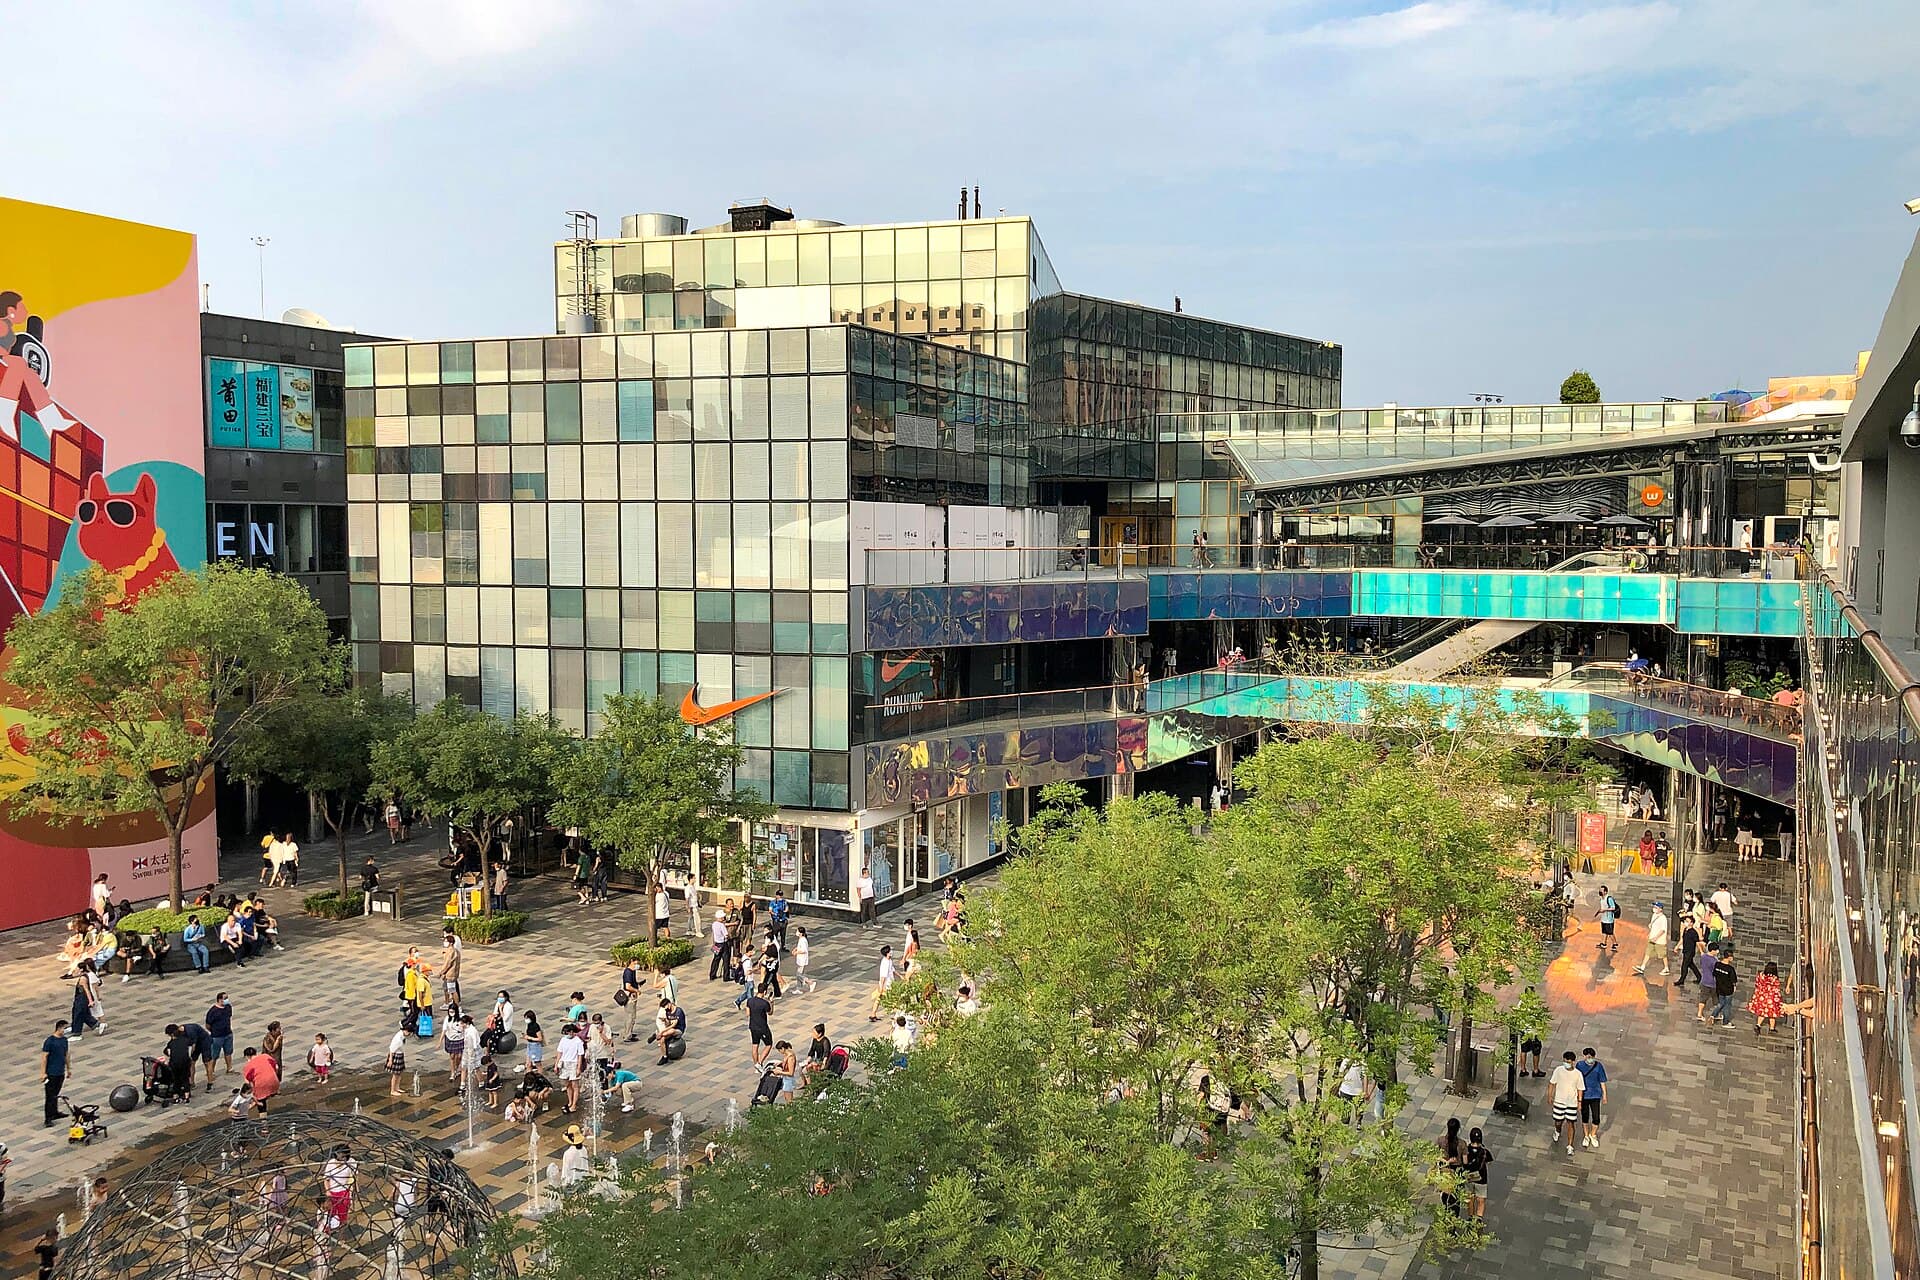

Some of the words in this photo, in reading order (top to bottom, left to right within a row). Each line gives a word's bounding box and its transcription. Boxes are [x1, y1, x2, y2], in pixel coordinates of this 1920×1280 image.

[217, 377, 238, 423] 莆田
[883, 691, 924, 717] RUNNING
[150, 848, 192, 867] 太古产
